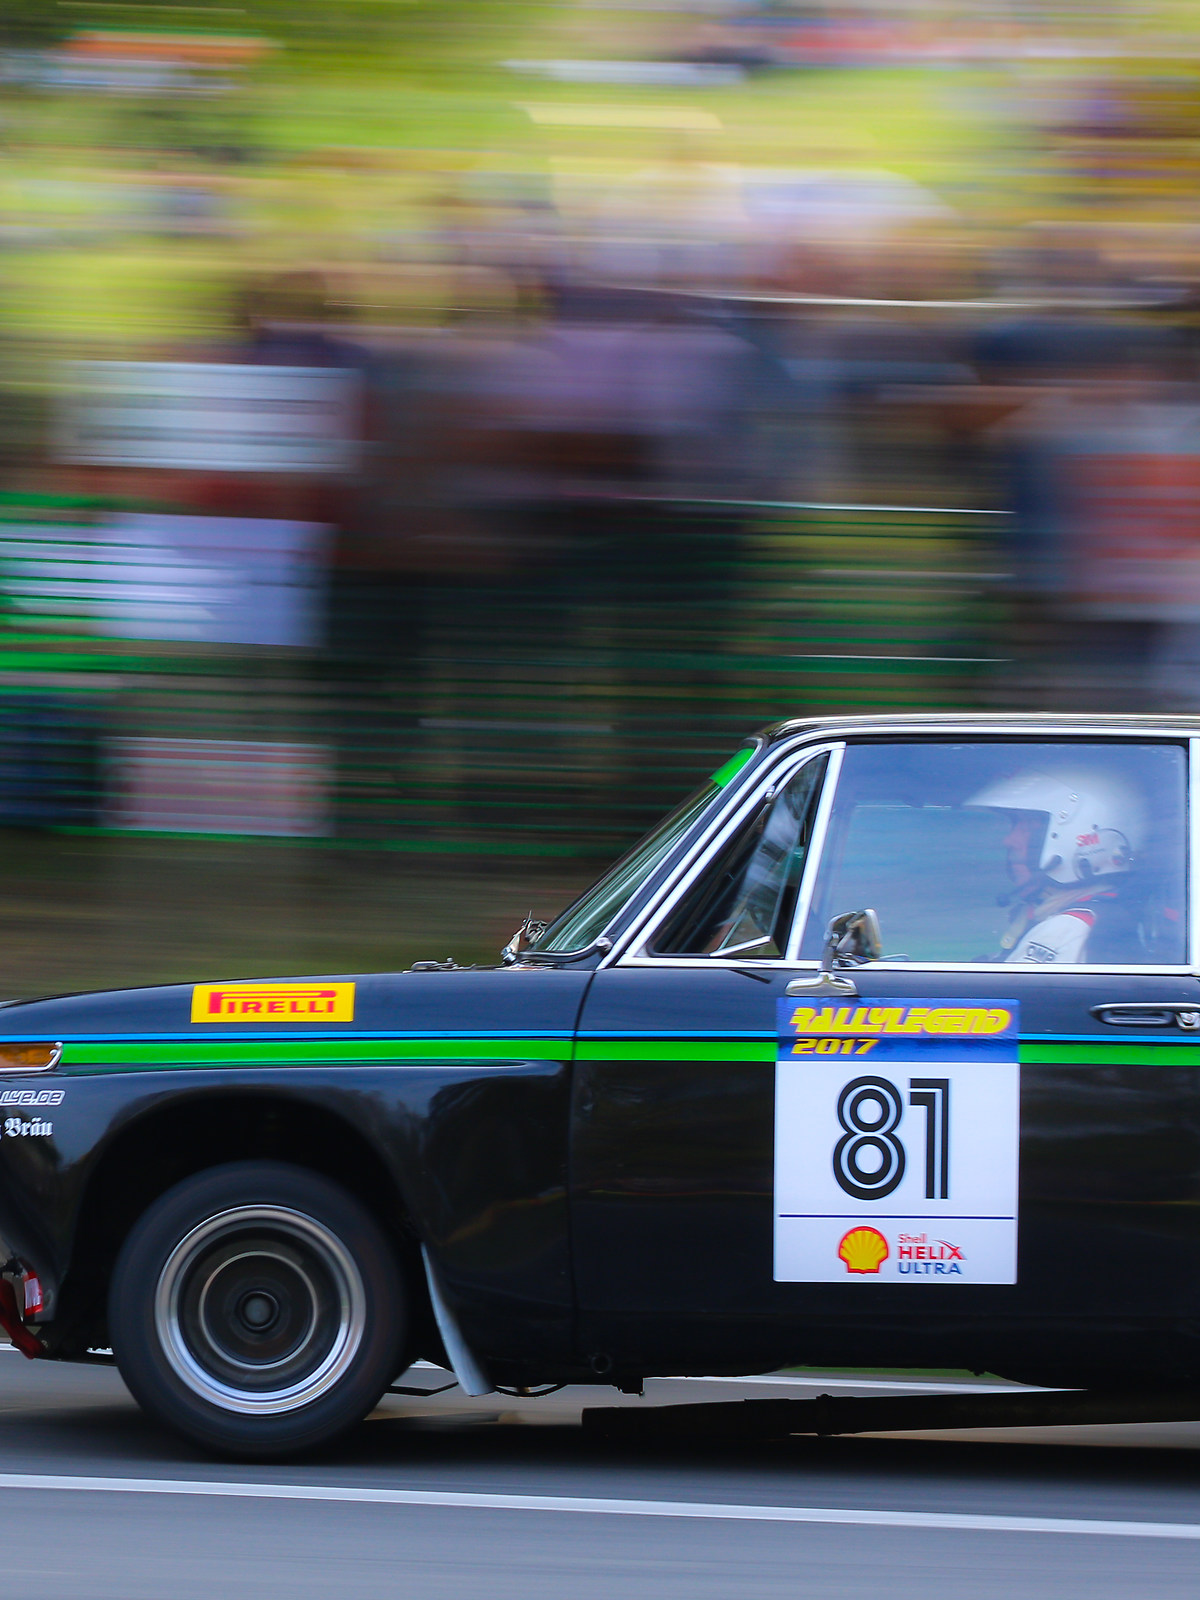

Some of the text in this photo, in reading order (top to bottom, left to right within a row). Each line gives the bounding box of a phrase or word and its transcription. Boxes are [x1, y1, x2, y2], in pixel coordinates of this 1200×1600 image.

[1076, 833, 1099, 847] 3M
[208, 990, 337, 1014] PIRELLI
[789, 1006, 1012, 1034] RALLYLEGEND
[791, 1038, 880, 1055] 2017
[4, 1117, 54, 1138] Bräu
[832, 1075, 950, 1201] 81
[897, 1233, 927, 1244] Shell
[897, 1244, 966, 1260] HELIX
[897, 1261, 962, 1275] ULTRA
